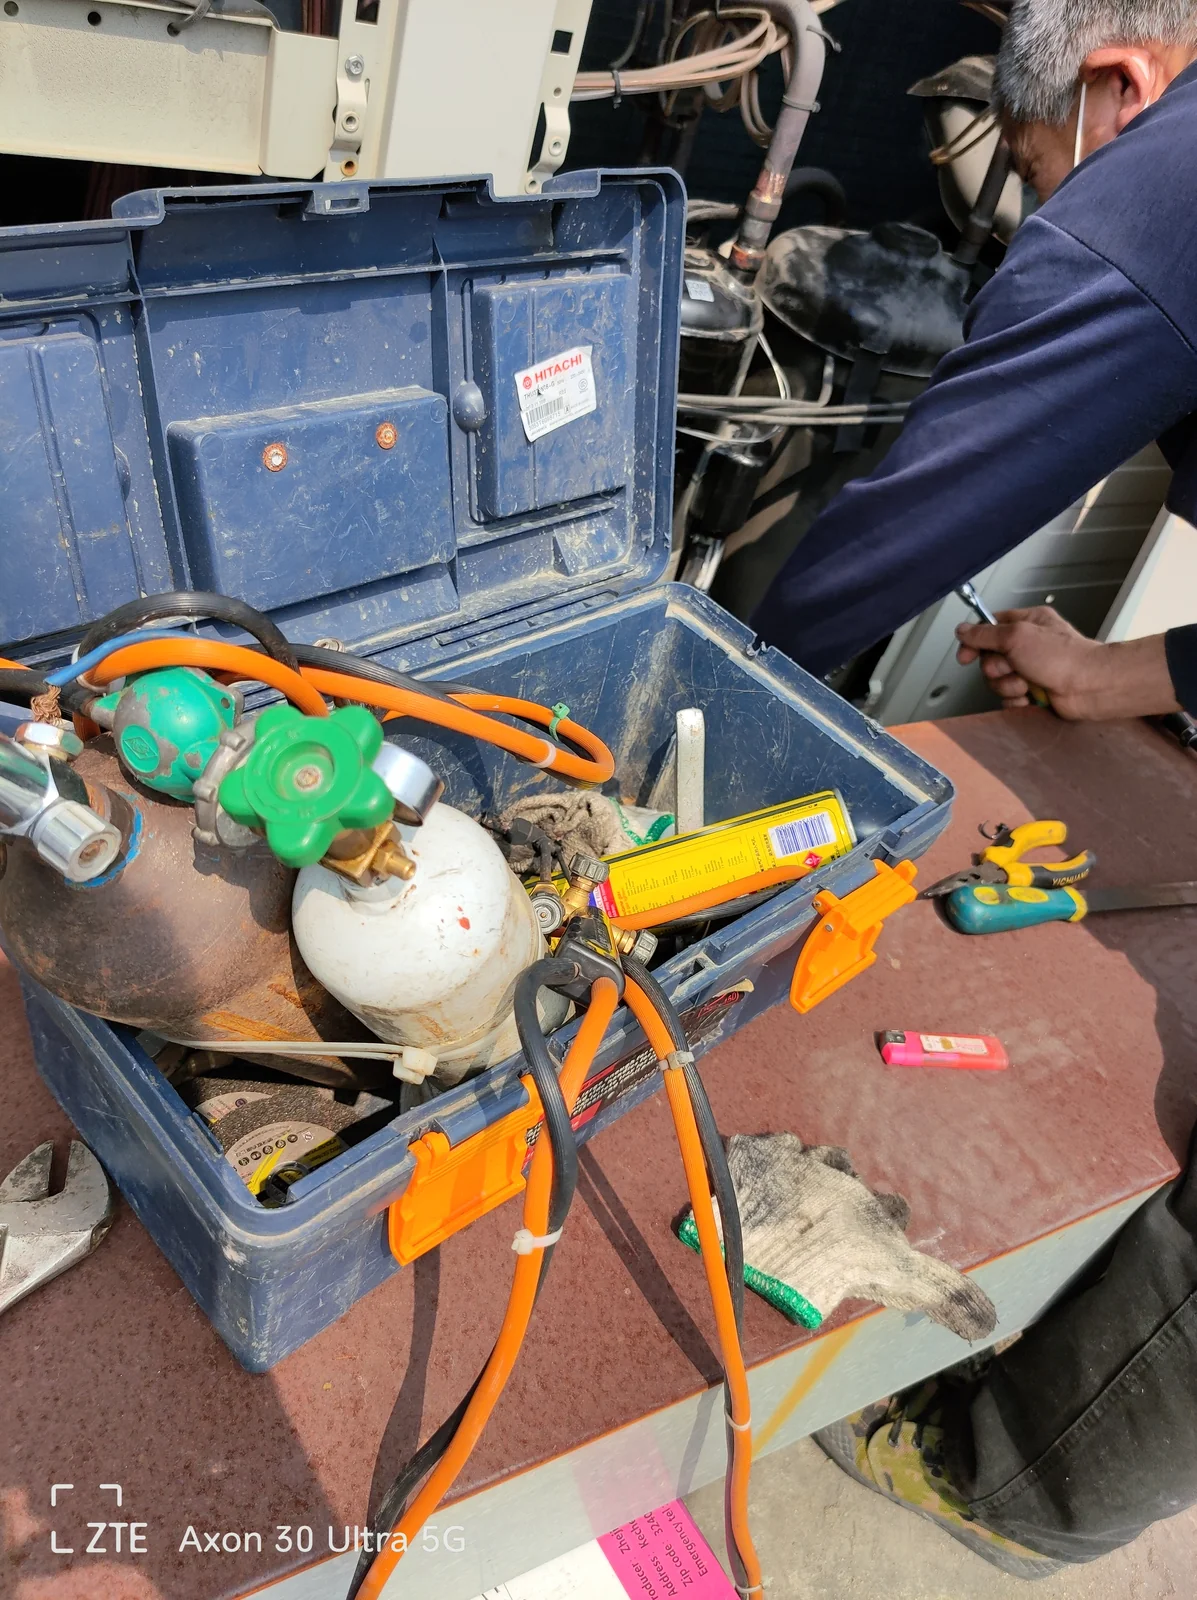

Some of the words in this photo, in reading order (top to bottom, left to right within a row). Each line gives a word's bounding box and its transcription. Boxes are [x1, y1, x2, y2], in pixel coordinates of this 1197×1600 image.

[535, 354, 583, 383] HITACHI
[672, 1521, 709, 1577] Emergency
[680, 1568, 694, 1587] Zip
